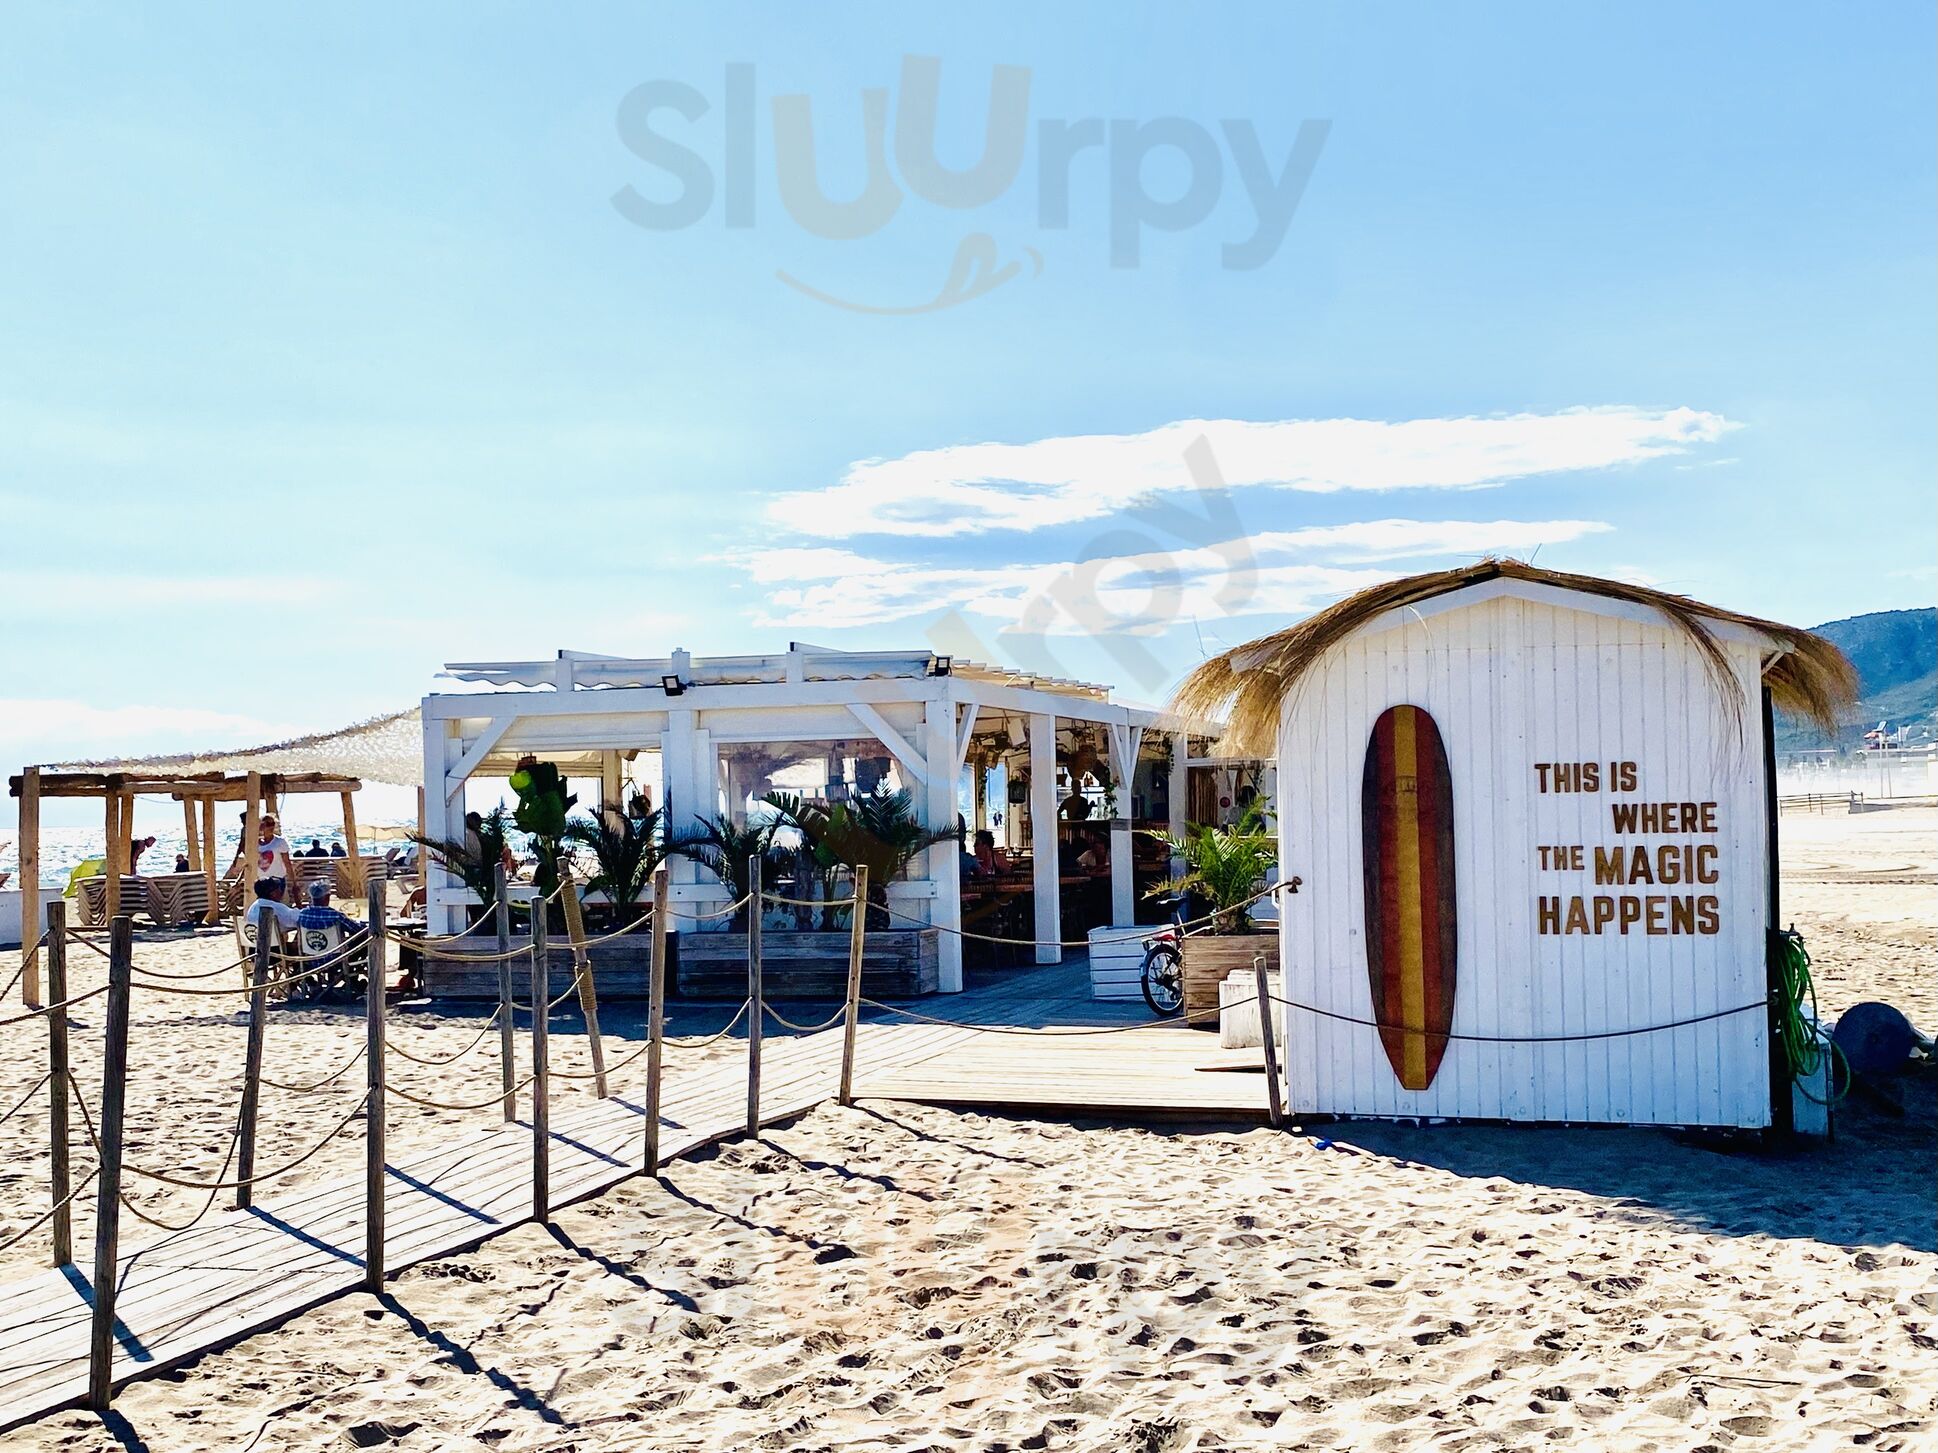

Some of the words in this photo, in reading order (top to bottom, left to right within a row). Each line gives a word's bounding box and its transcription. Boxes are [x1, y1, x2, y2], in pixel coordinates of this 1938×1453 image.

[1534, 762, 1600, 794] THIS
[1610, 761, 1637, 793] IS
[1611, 801, 1719, 835] WHERE
[1537, 845, 1585, 871] THE
[1594, 844, 1719, 886] MAGIC
[1538, 895, 1720, 936] HAPPENS
